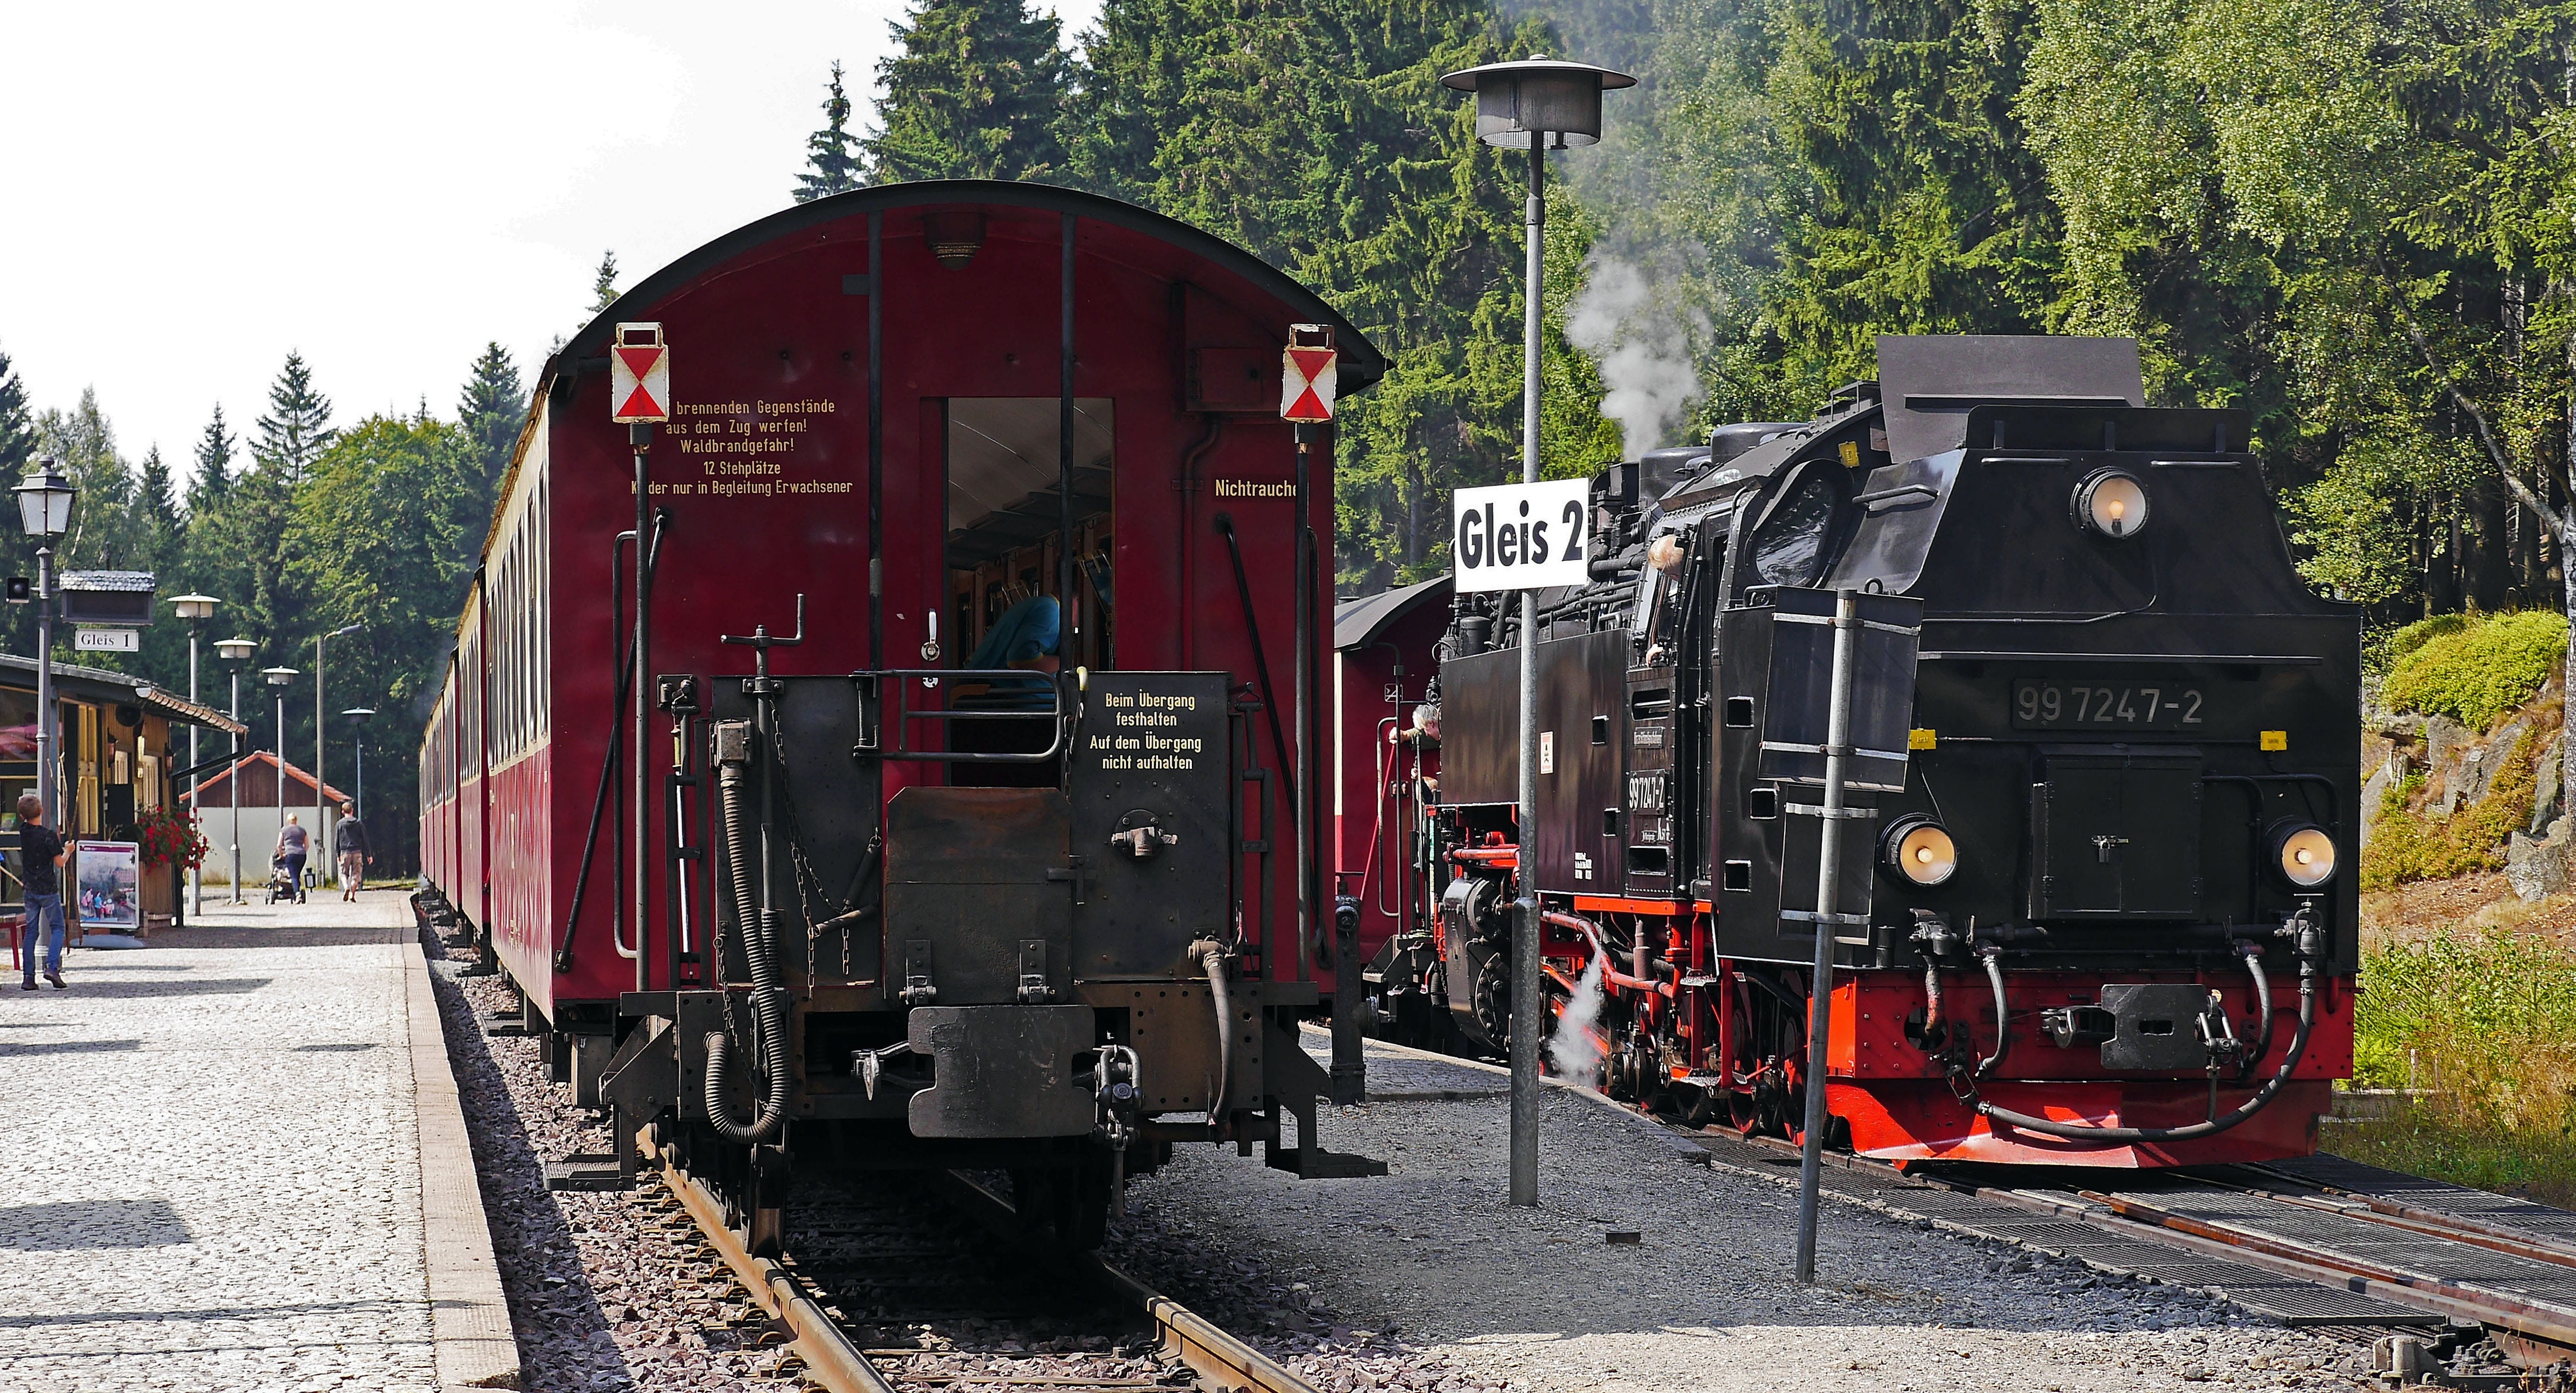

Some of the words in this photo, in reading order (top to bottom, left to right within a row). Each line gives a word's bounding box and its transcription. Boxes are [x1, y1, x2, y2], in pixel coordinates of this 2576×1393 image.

[677, 400, 749, 415] brennenden
[758, 399, 834, 416] Gegenstände
[665, 423, 687, 435] aus
[695, 420, 720, 434] dem
[729, 420, 750, 436] Zug
[759, 419, 807, 433] werfen!
[681, 438, 794, 455] Waldbrandgefahr!
[704, 461, 715, 475] 12
[720, 461, 781, 478] Stehplätze
[632, 480, 668, 494] Kder
[673, 484, 693, 494] nur
[698, 481, 707, 494] in
[712, 480, 771, 497] Begleitung
[776, 480, 853, 494] Erwachsener
[1460, 500, 1548, 569] Gleis
[1562, 500, 1583, 561] 2
[81, 634, 115, 645] Gleis
[124, 634, 129, 647] 1
[1105, 693, 1134, 707] Beim
[1139, 689, 1195, 710] Übergang
[2019, 687, 2061, 721] 99
[2071, 688, 2202, 723] 7247-2
[1116, 712, 1177, 726] festhalten
[1090, 735, 1110, 749] Auf
[1115, 735, 1140, 749] dem
[1145, 731, 1202, 753] Übergang
[1102, 755, 1132, 769] nicht
[1137, 755, 1192, 769] aufhalten
[1629, 778, 1639, 808] 99
[1639, 777, 1664, 808] 7247-2
